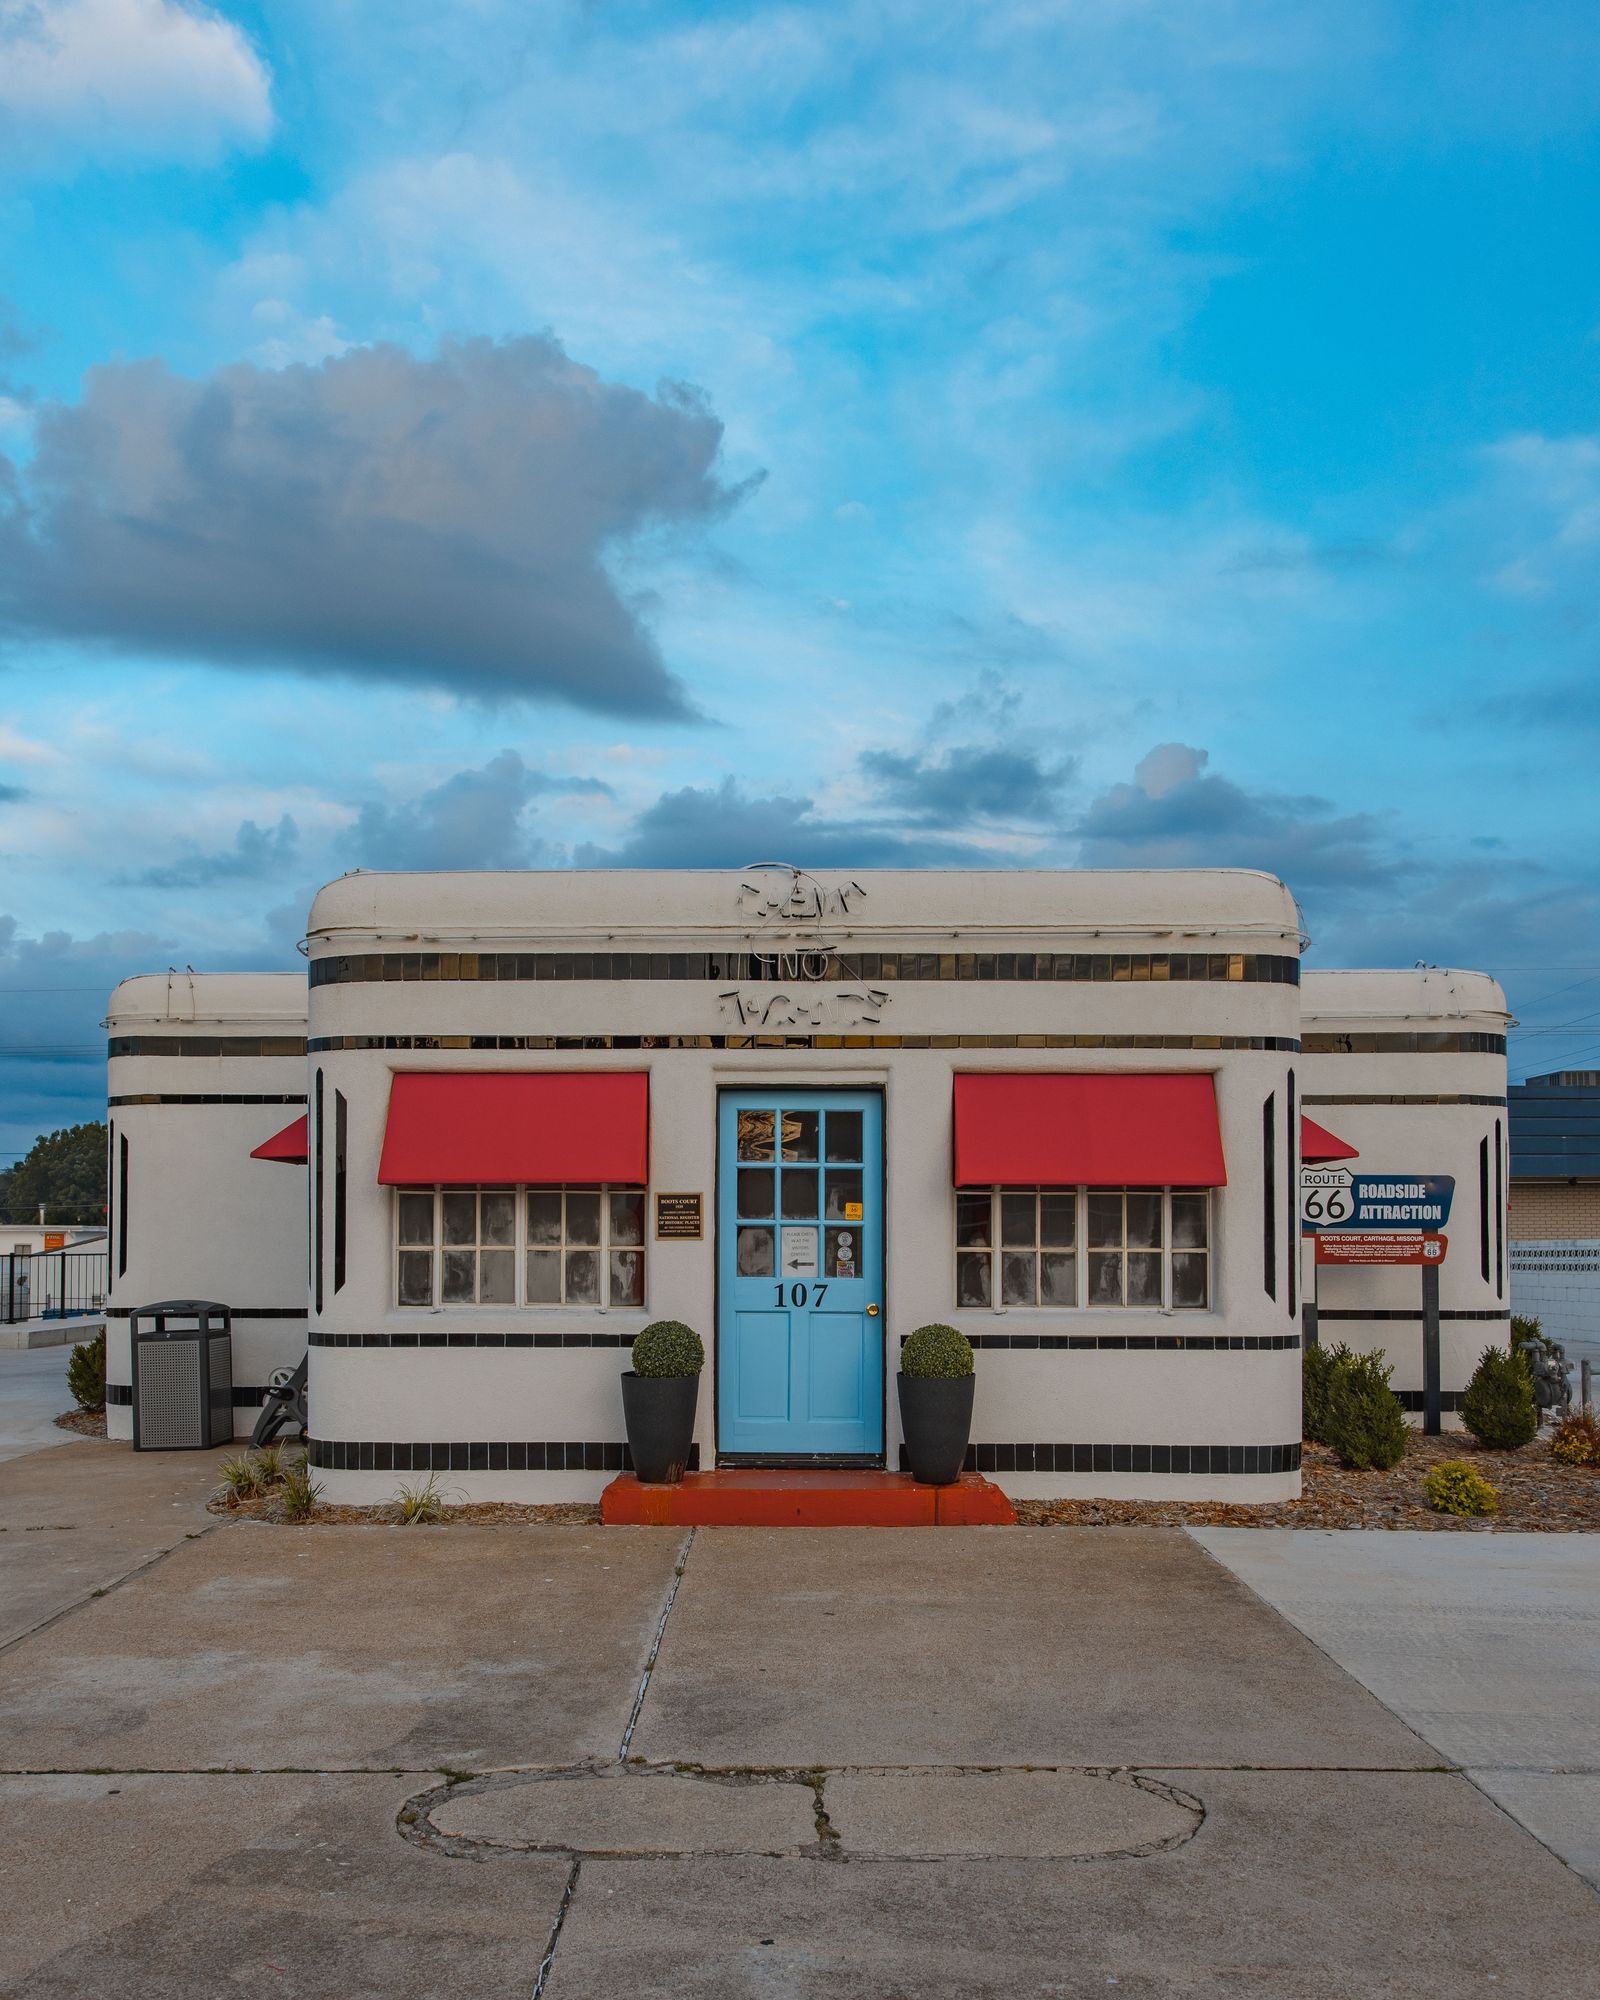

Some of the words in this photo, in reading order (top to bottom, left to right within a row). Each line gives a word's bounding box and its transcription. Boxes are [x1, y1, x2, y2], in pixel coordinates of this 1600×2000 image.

[1304, 1174, 1345, 1185] ROUTE
[1359, 1184, 1426, 1199] ROADSIDE
[1305, 1189, 1345, 1219] 66
[1359, 1205, 1441, 1220] ATTRACTION
[774, 1283, 829, 1308] 107
